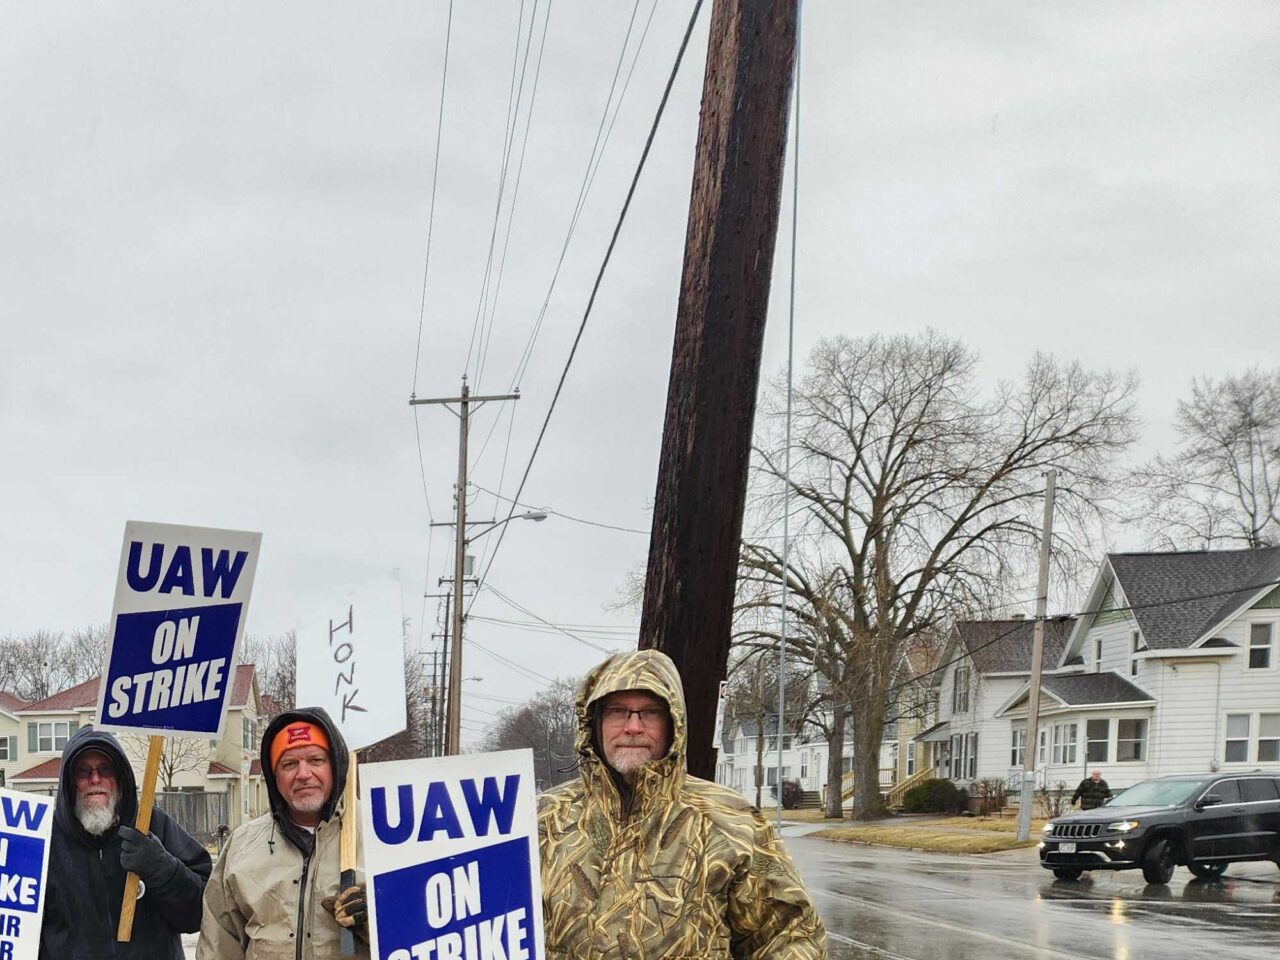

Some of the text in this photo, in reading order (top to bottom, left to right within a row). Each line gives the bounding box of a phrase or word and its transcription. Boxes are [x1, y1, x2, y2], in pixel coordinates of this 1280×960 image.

[126, 540, 249, 599] UAW
[151, 615, 201, 665] ON
[329, 604, 369, 724] HONK
[108, 656, 226, 719] STRIKE
[370, 774, 521, 846] UAW
[425, 860, 482, 929] ON
